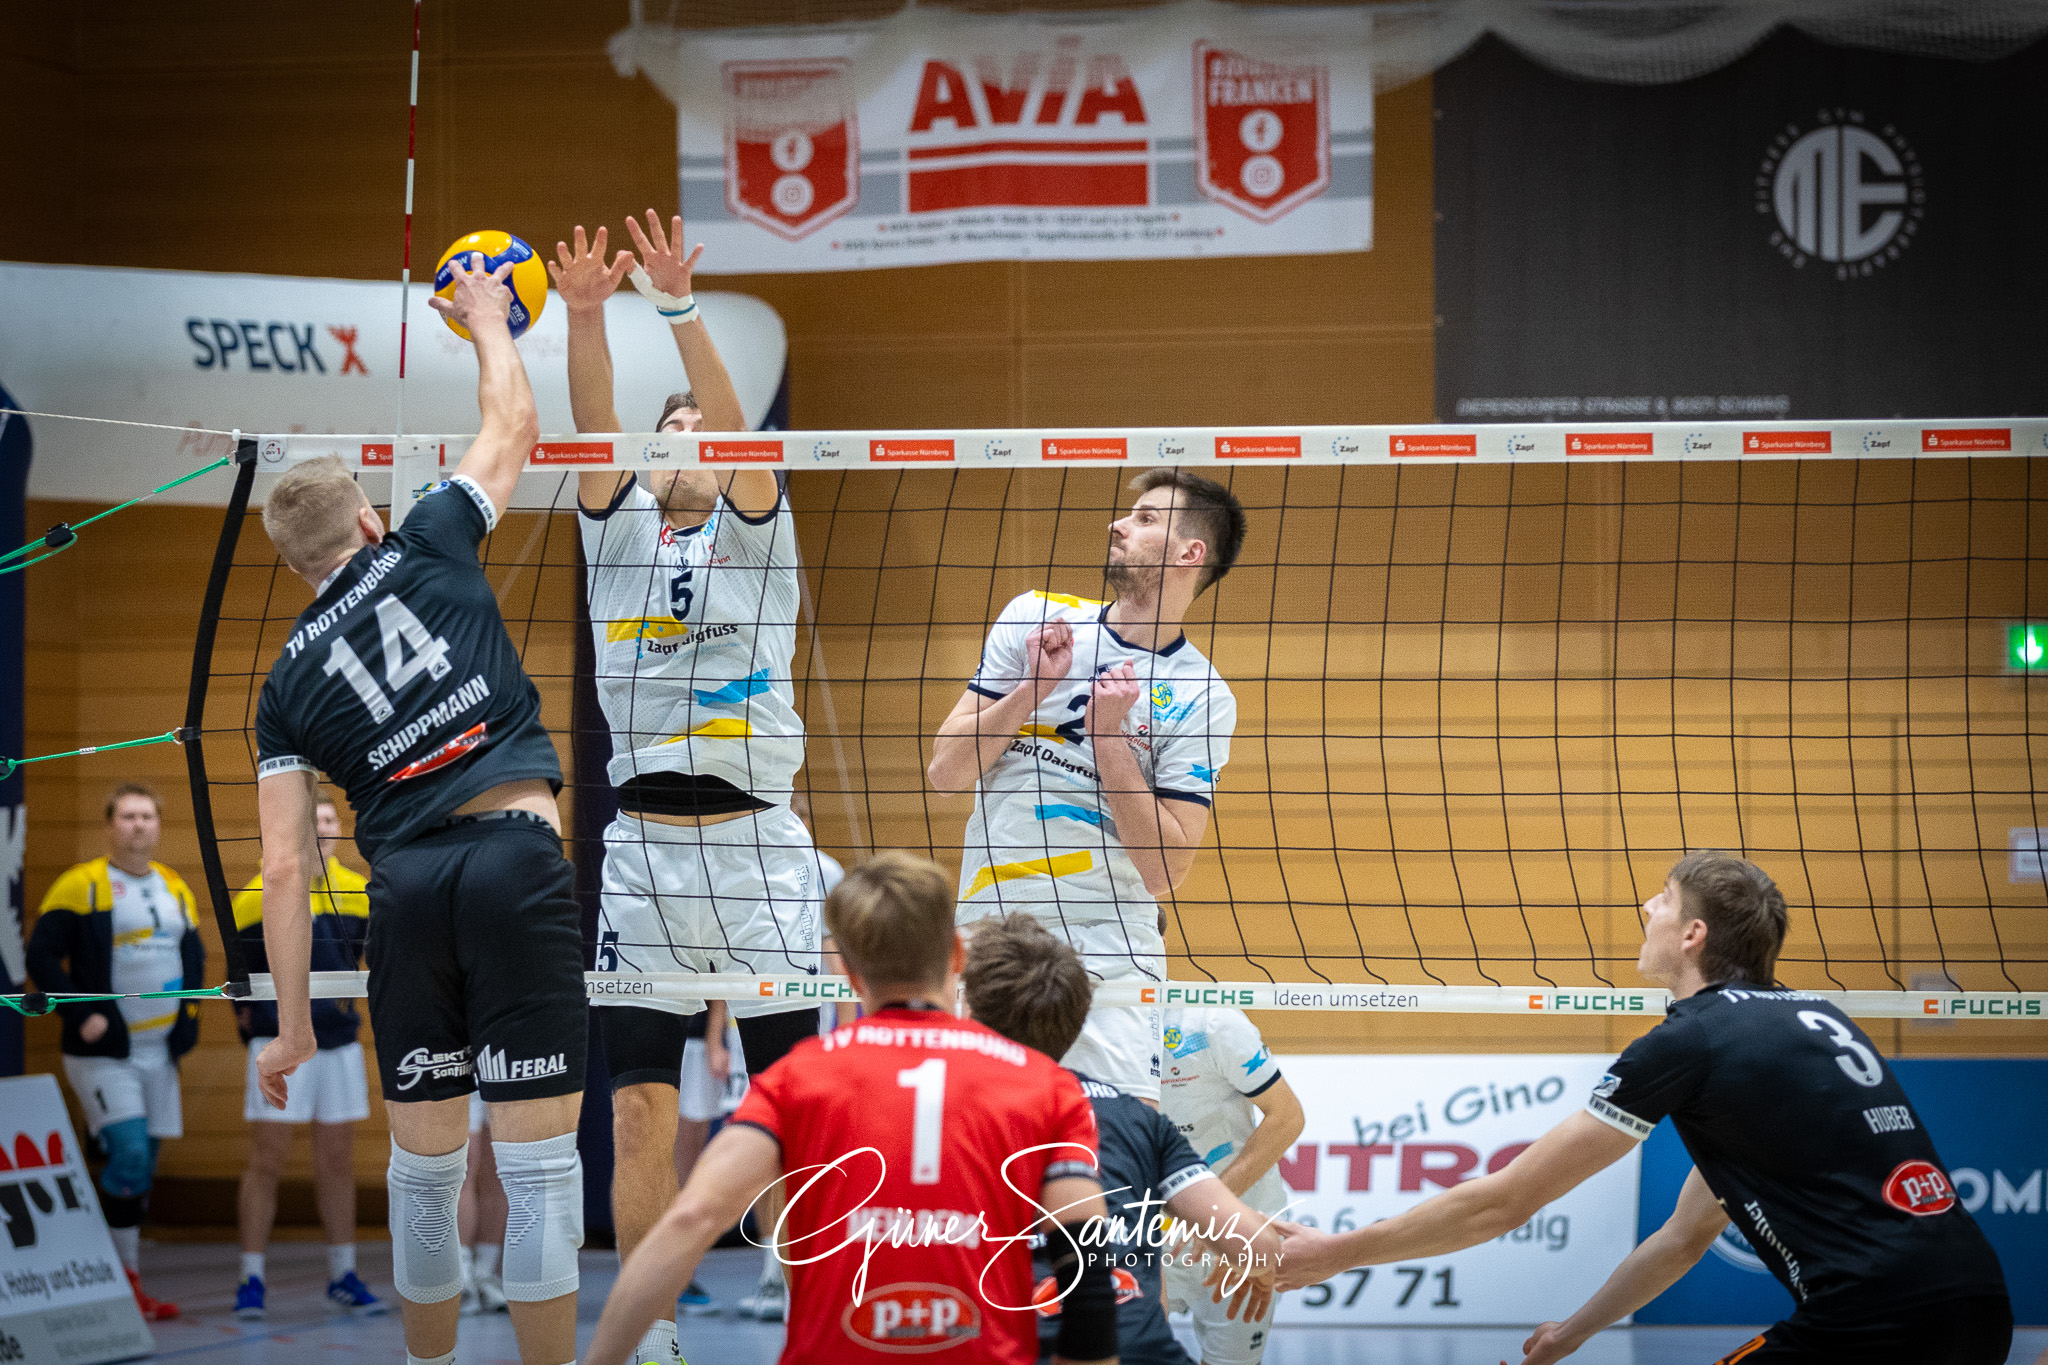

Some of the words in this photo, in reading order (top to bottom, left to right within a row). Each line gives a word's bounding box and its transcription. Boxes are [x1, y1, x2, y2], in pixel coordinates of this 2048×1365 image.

[186, 316, 328, 375] SPECK
[1407, 443, 1439, 453] Sparkasse
[1440, 442, 1471, 453] Nürnberg
[1515, 443, 1535, 453] Zapf
[1583, 442, 1616, 452] Sparkasse
[1617, 441, 1648, 451] Nürnberg
[1692, 441, 1712, 451] Zapf
[1761, 440, 1794, 450] Sparkasse
[1794, 439, 1826, 449] Nürnberg
[1870, 439, 1891, 449] Zapf
[1940, 438, 1973, 448] Sparkasse
[1974, 437, 2006, 447] Nürnberg
[547, 451, 577, 461] Sparkasse
[578, 450, 609, 461] Nürnberg
[651, 450, 670, 460] Zapf
[716, 450, 748, 460] Sparkasse
[748, 448, 779, 459] Nürnberg
[821, 449, 840, 459] Zapf
[887, 448, 918, 458] Sparkasse
[919, 447, 949, 457] Nürnberg
[992, 448, 1012, 458] Zapf
[1059, 447, 1091, 457] Sparkasse
[1091, 445, 1122, 456] Nürnberg
[1165, 446, 1185, 456] Zapf
[1232, 445, 1265, 455] Sparkasse
[1265, 444, 1296, 454] Nürnberg
[1339, 445, 1359, 454] Zapf
[671, 571, 694, 621] 5
[285, 637, 306, 660] TV
[306, 550, 402, 643] ROTTENBURG
[322, 593, 453, 725] 14
[367, 674, 491, 771] SCHIPPMANN
[1010, 739, 1042, 758] Zapf
[785, 981, 860, 998] FUCH
[1167, 988, 1254, 1005] FUCHS
[1274, 989, 1323, 1007] Ideen
[1329, 991, 1418, 1008] umsetzen
[1555, 994, 1645, 1011] FUCHS
[1951, 999, 2041, 1016] FUCHS
[1796, 1009, 1884, 1088] 3
[510, 1053, 568, 1079] FERAL
[1355, 1101, 1429, 1149] bei
[1444, 1075, 1565, 1126] Gino
[897, 1058, 947, 1185] 1
[1862, 1104, 1916, 1135] HUBER
